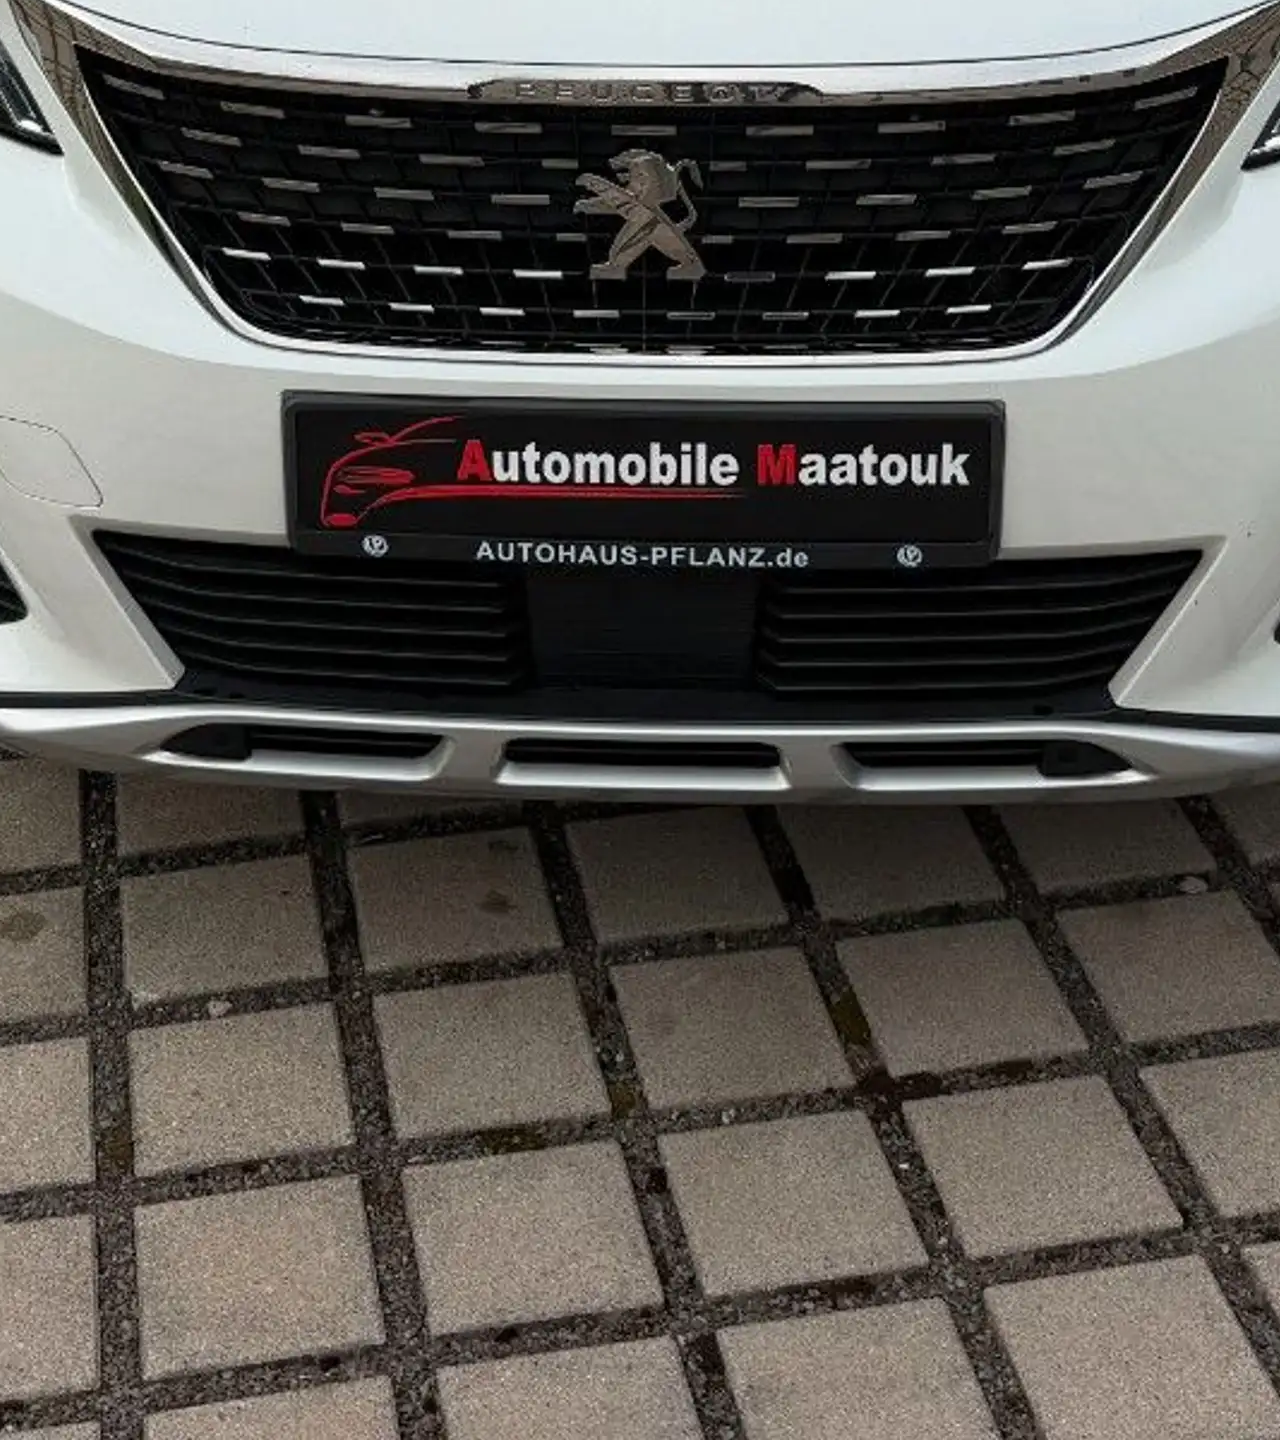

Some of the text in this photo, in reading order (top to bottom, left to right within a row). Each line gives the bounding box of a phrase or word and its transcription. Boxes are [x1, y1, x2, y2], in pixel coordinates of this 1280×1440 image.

[457, 439, 970, 486] Automobile Maatouk
[476, 540, 809, 568] AUTOHAUS-PFLANZ.de
